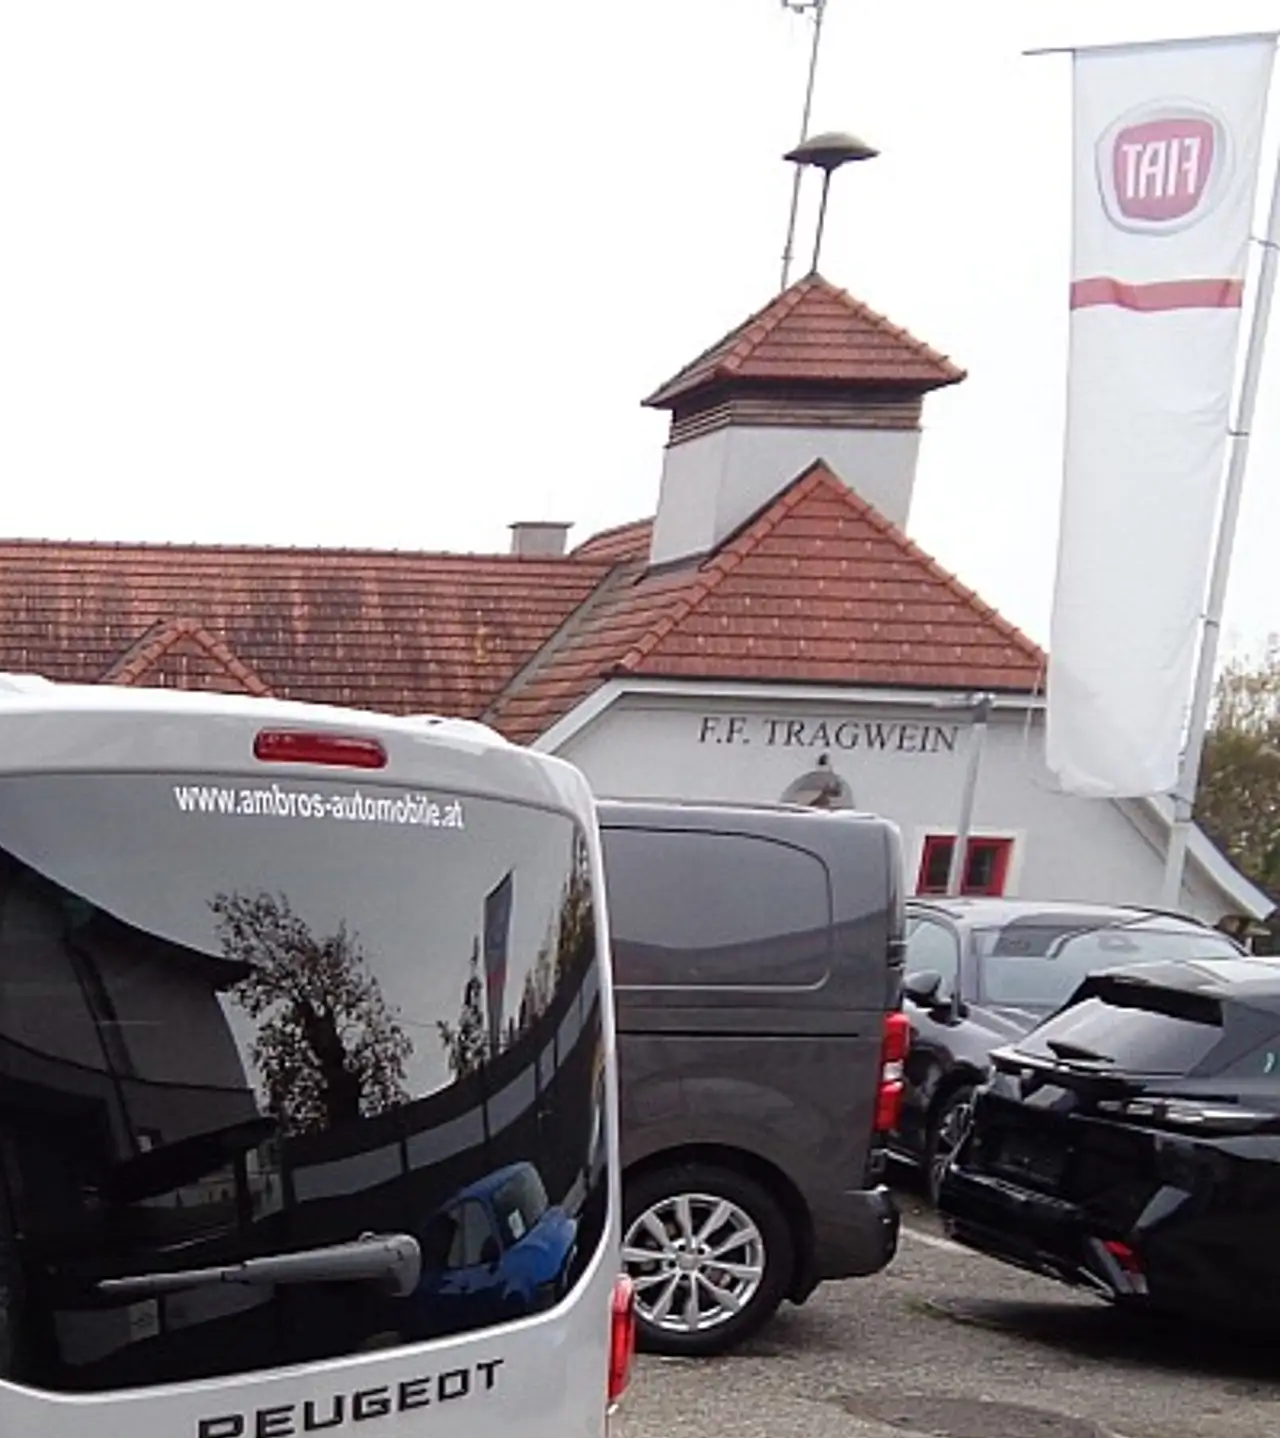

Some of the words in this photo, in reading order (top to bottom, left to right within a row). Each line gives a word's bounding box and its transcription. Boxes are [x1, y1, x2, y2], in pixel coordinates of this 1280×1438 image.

[697, 715, 750, 745] F.F.
[763, 718, 960, 753] TRAGWEIN
[173, 782, 467, 830] www.ambros-automobile.at
